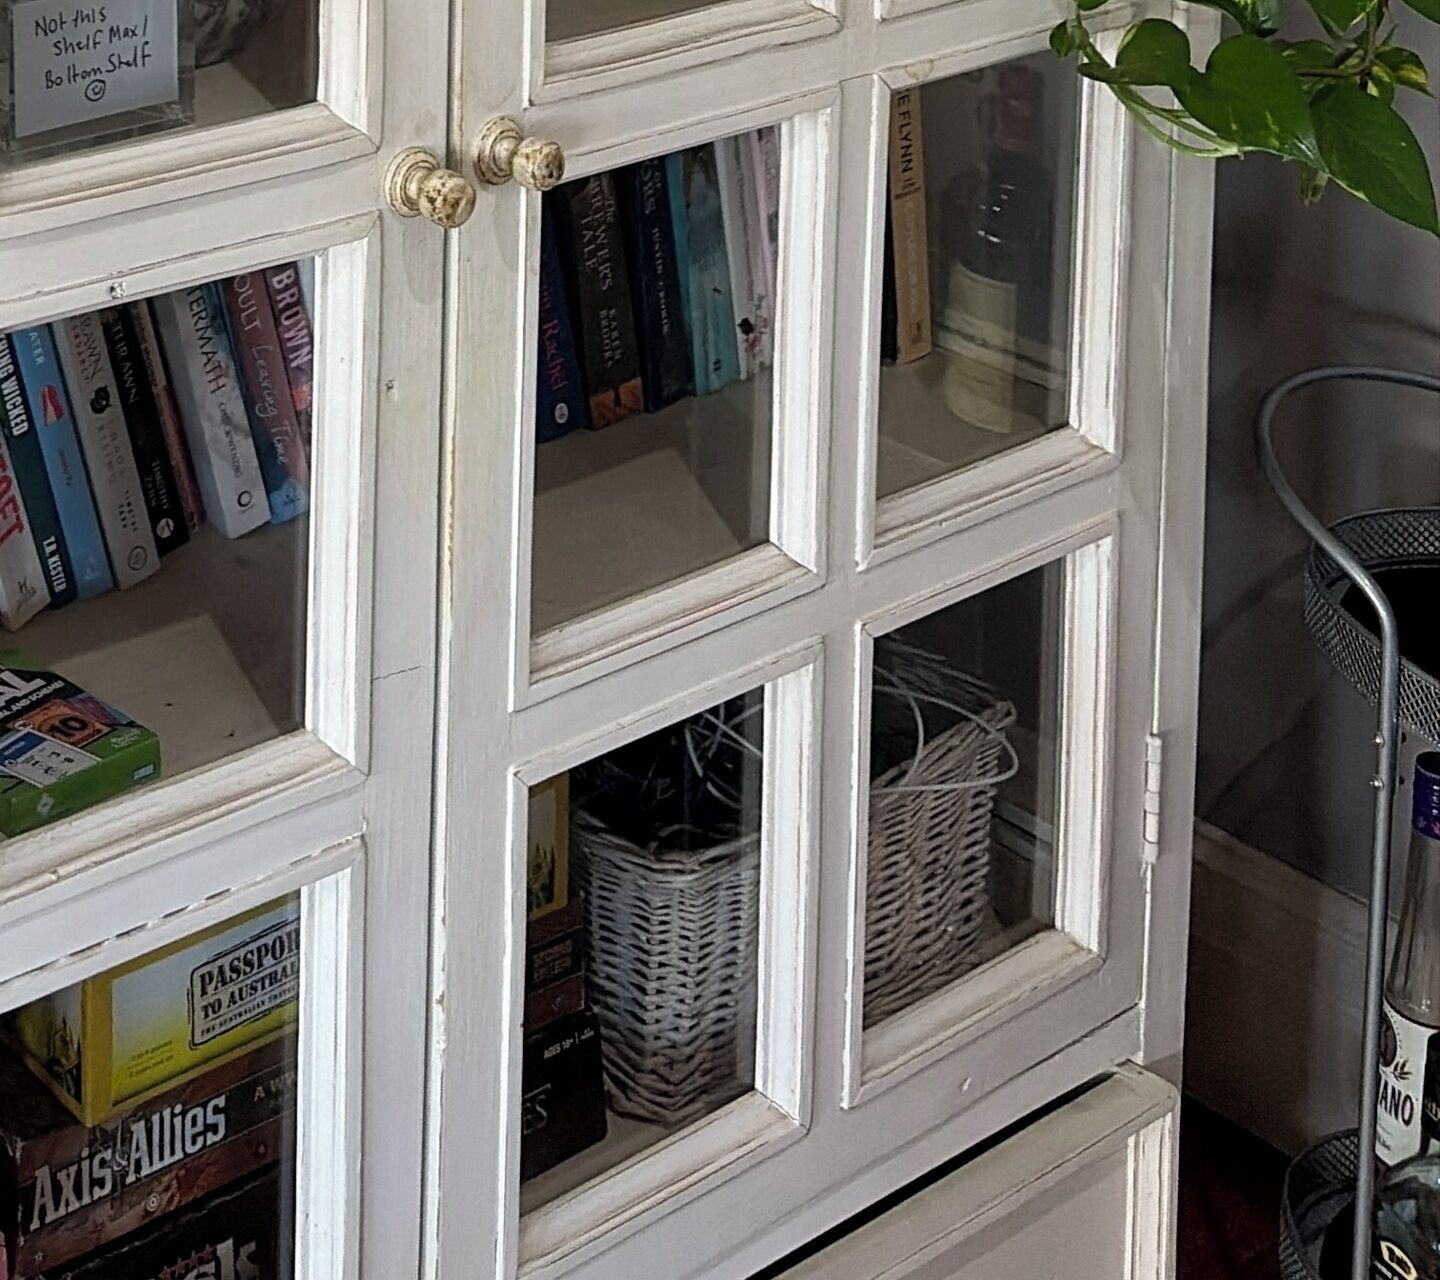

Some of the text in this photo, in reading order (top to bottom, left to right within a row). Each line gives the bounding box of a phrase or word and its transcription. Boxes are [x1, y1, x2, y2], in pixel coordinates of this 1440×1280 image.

[34, 6, 107, 37] Not this
[45, 64, 102, 89] Bottom
[896, 113, 915, 179] FLYNN
[272, 270, 312, 368] BROWN
[541, 320, 568, 391] Rachel
[0, 376, 30, 438] WICKED
[251, 343, 280, 418] Leaving
[268, 421, 293, 466] Time
[46, 553, 68, 594] KESTER
[202, 998, 223, 1020] TO
[29, 1146, 112, 1233] Axis
[125, 1093, 227, 1187] Allies
